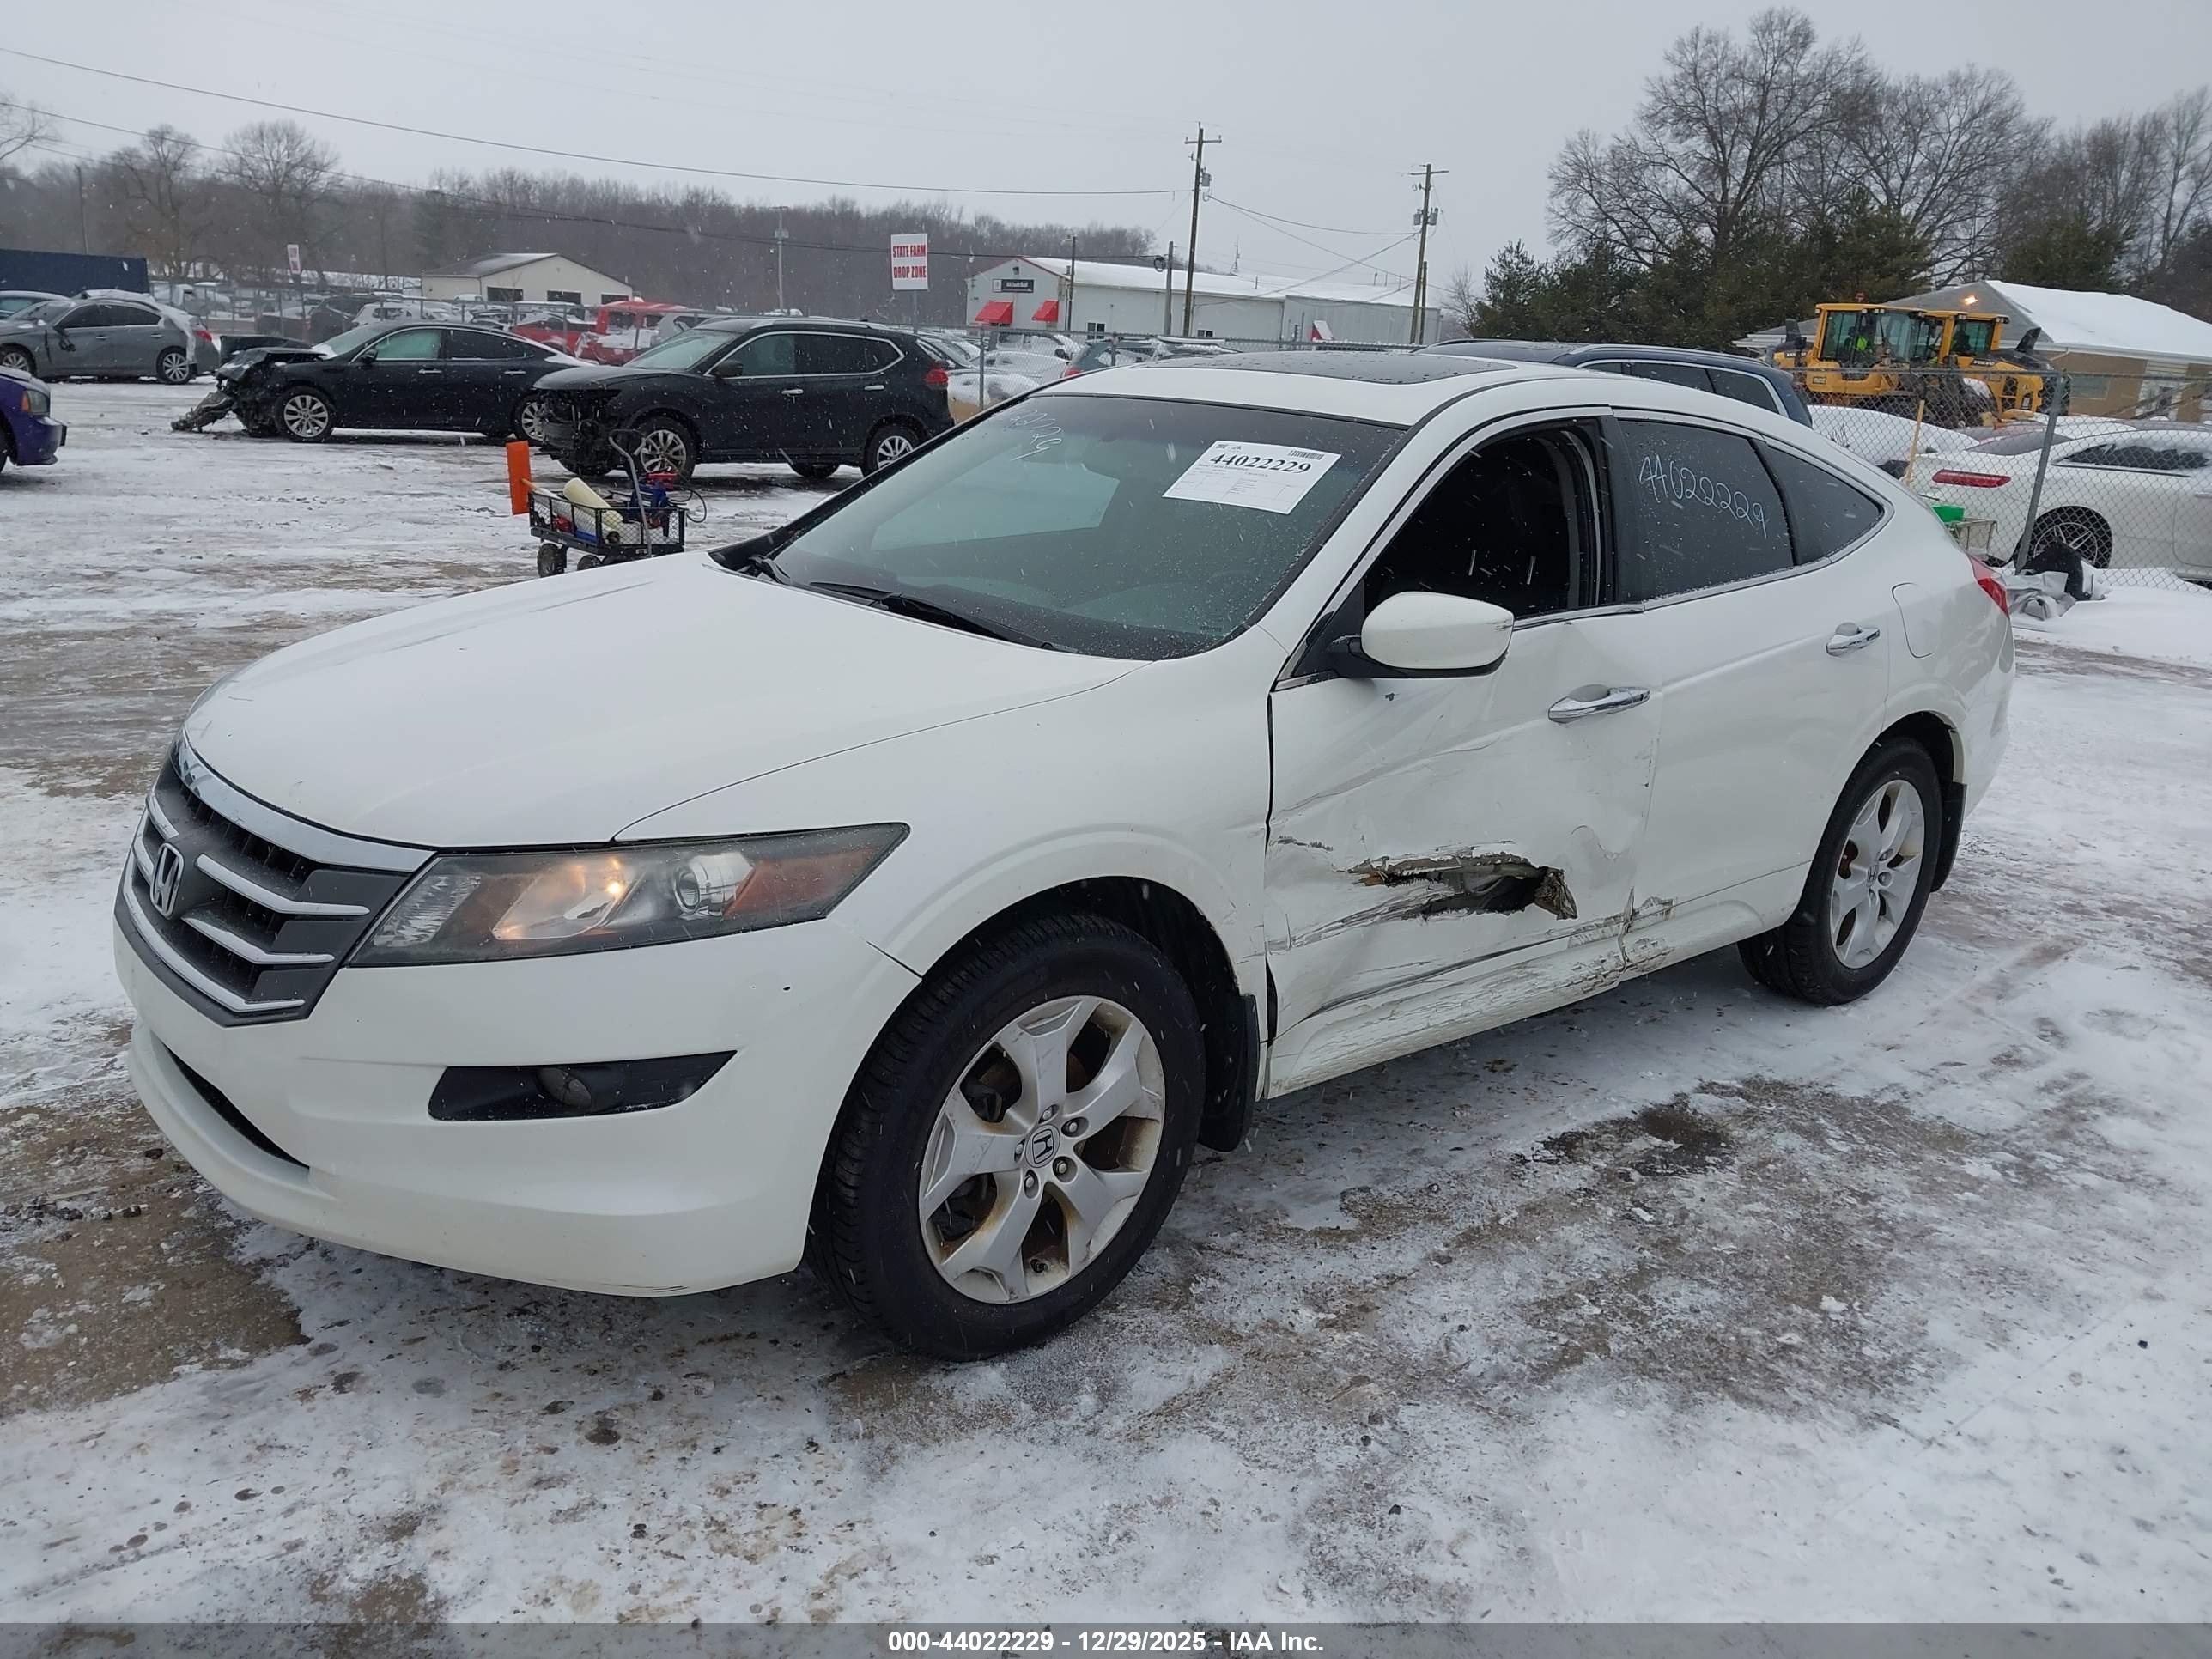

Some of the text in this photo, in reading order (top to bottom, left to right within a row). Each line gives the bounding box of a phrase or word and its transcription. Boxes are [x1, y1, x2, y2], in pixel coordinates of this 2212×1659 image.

[893, 245, 927, 258] STATE FARM
[894, 265, 927, 279] DROP ZONE
[1210, 453, 1312, 474] 44022229
[1639, 454, 1767, 539] 44022229
